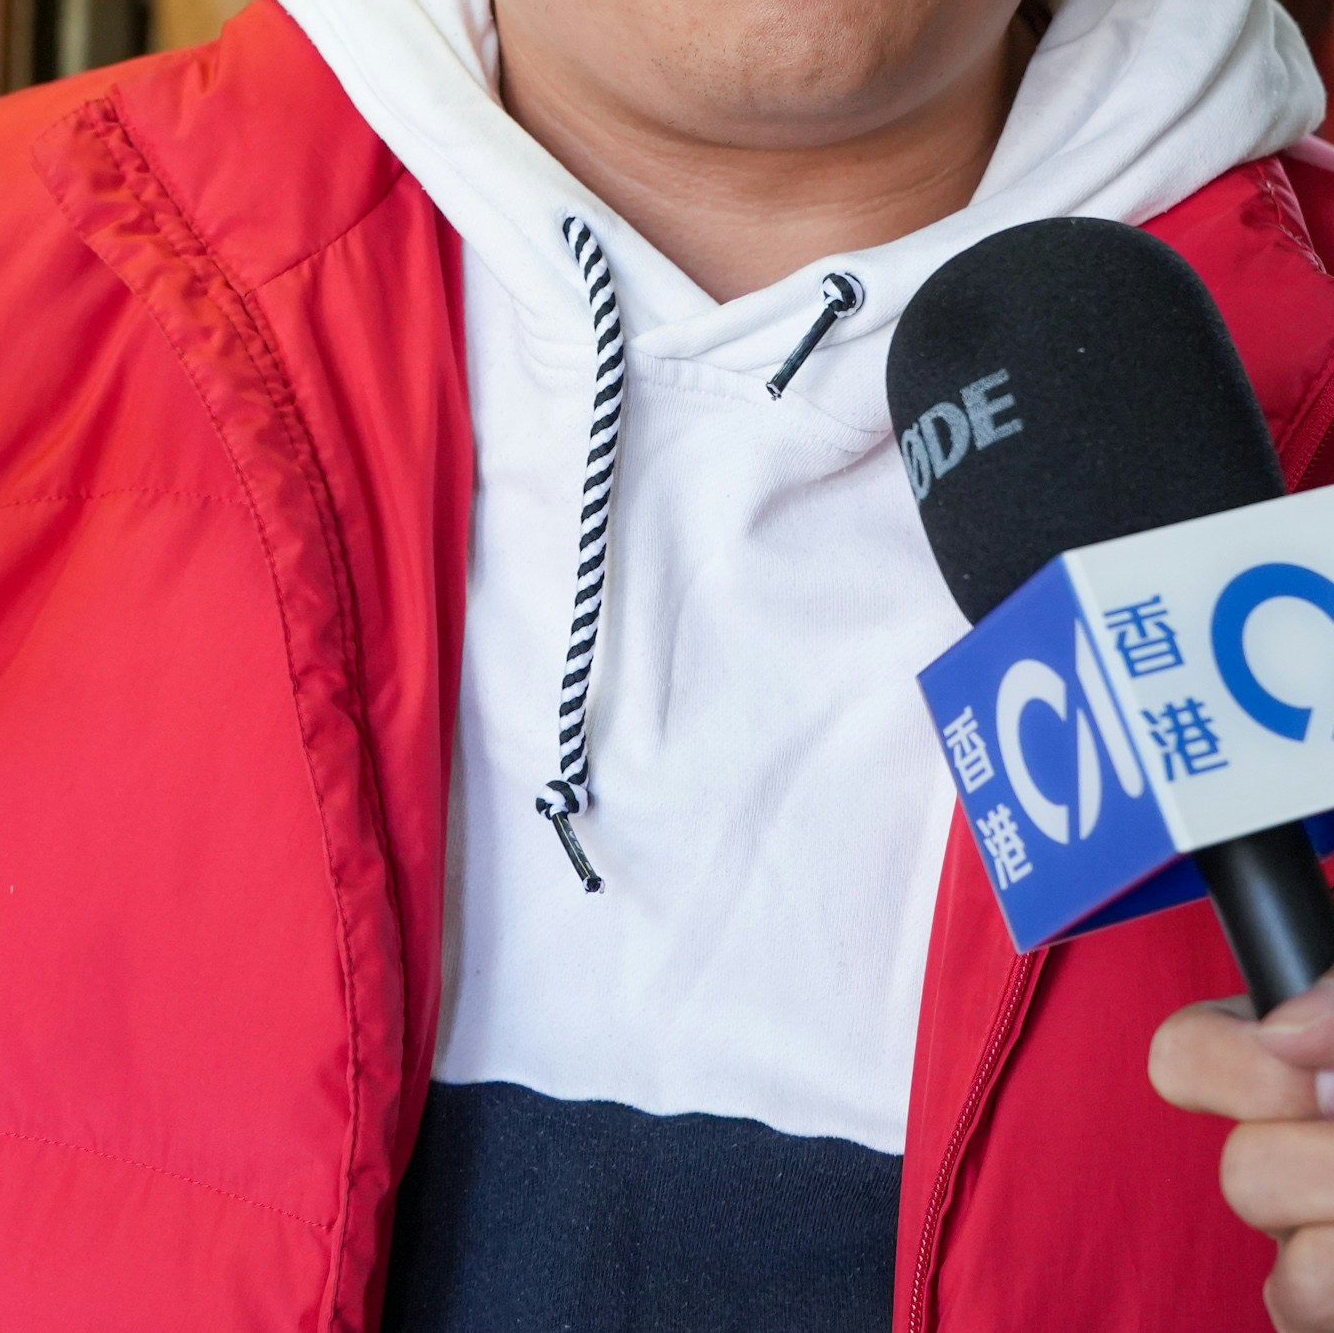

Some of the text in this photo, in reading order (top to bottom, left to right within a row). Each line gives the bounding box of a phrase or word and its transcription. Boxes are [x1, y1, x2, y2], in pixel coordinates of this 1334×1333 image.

[901, 368, 1024, 501] ØDE
[1103, 595, 1230, 781] 香港
[943, 706, 1033, 890] 香港
